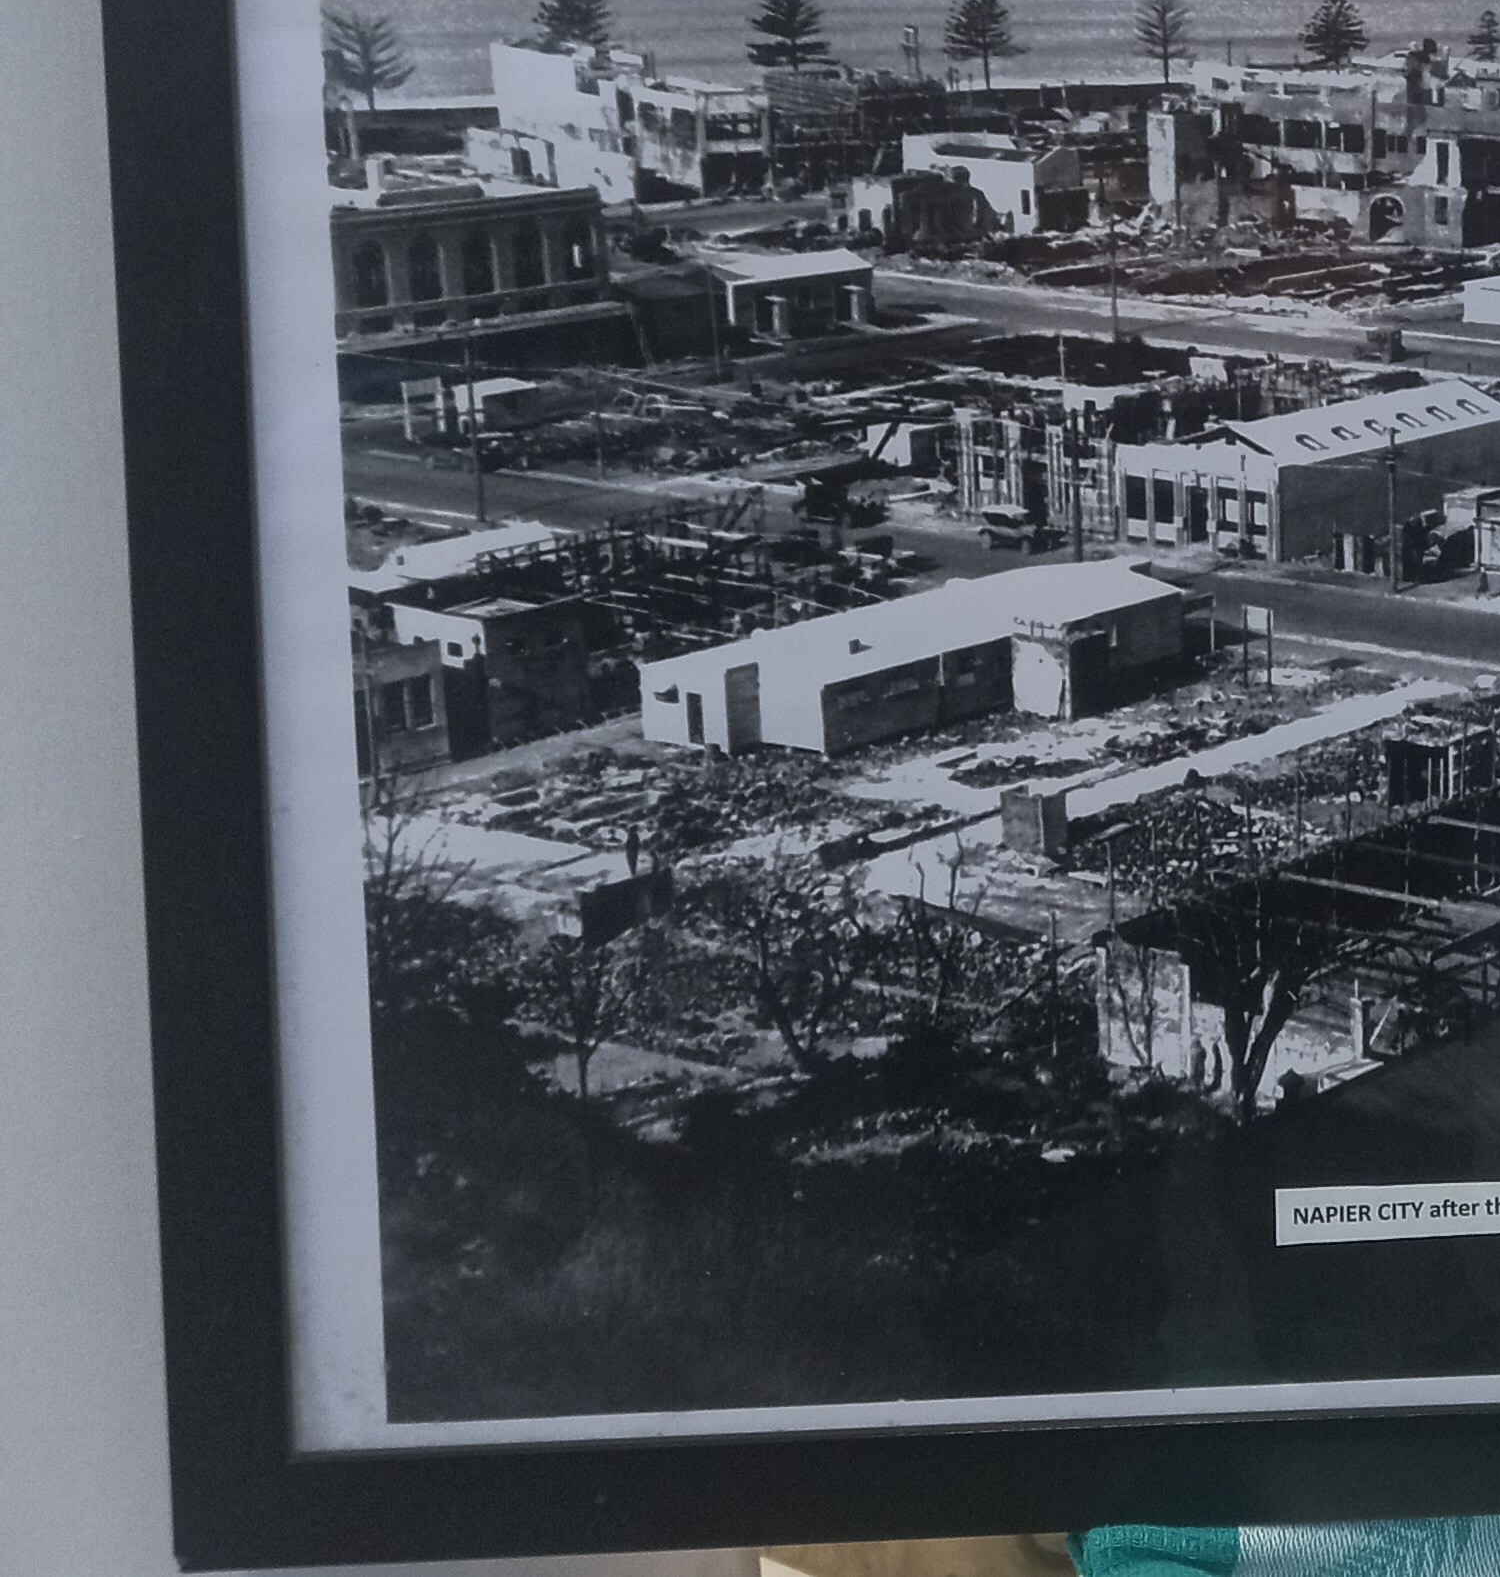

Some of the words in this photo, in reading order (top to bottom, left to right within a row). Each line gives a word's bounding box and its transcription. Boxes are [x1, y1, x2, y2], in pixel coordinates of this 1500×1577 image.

[1292, 1203, 1373, 1226] NAPIER
[1376, 1201, 1425, 1222] CITY
[1429, 1198, 1481, 1219] after
